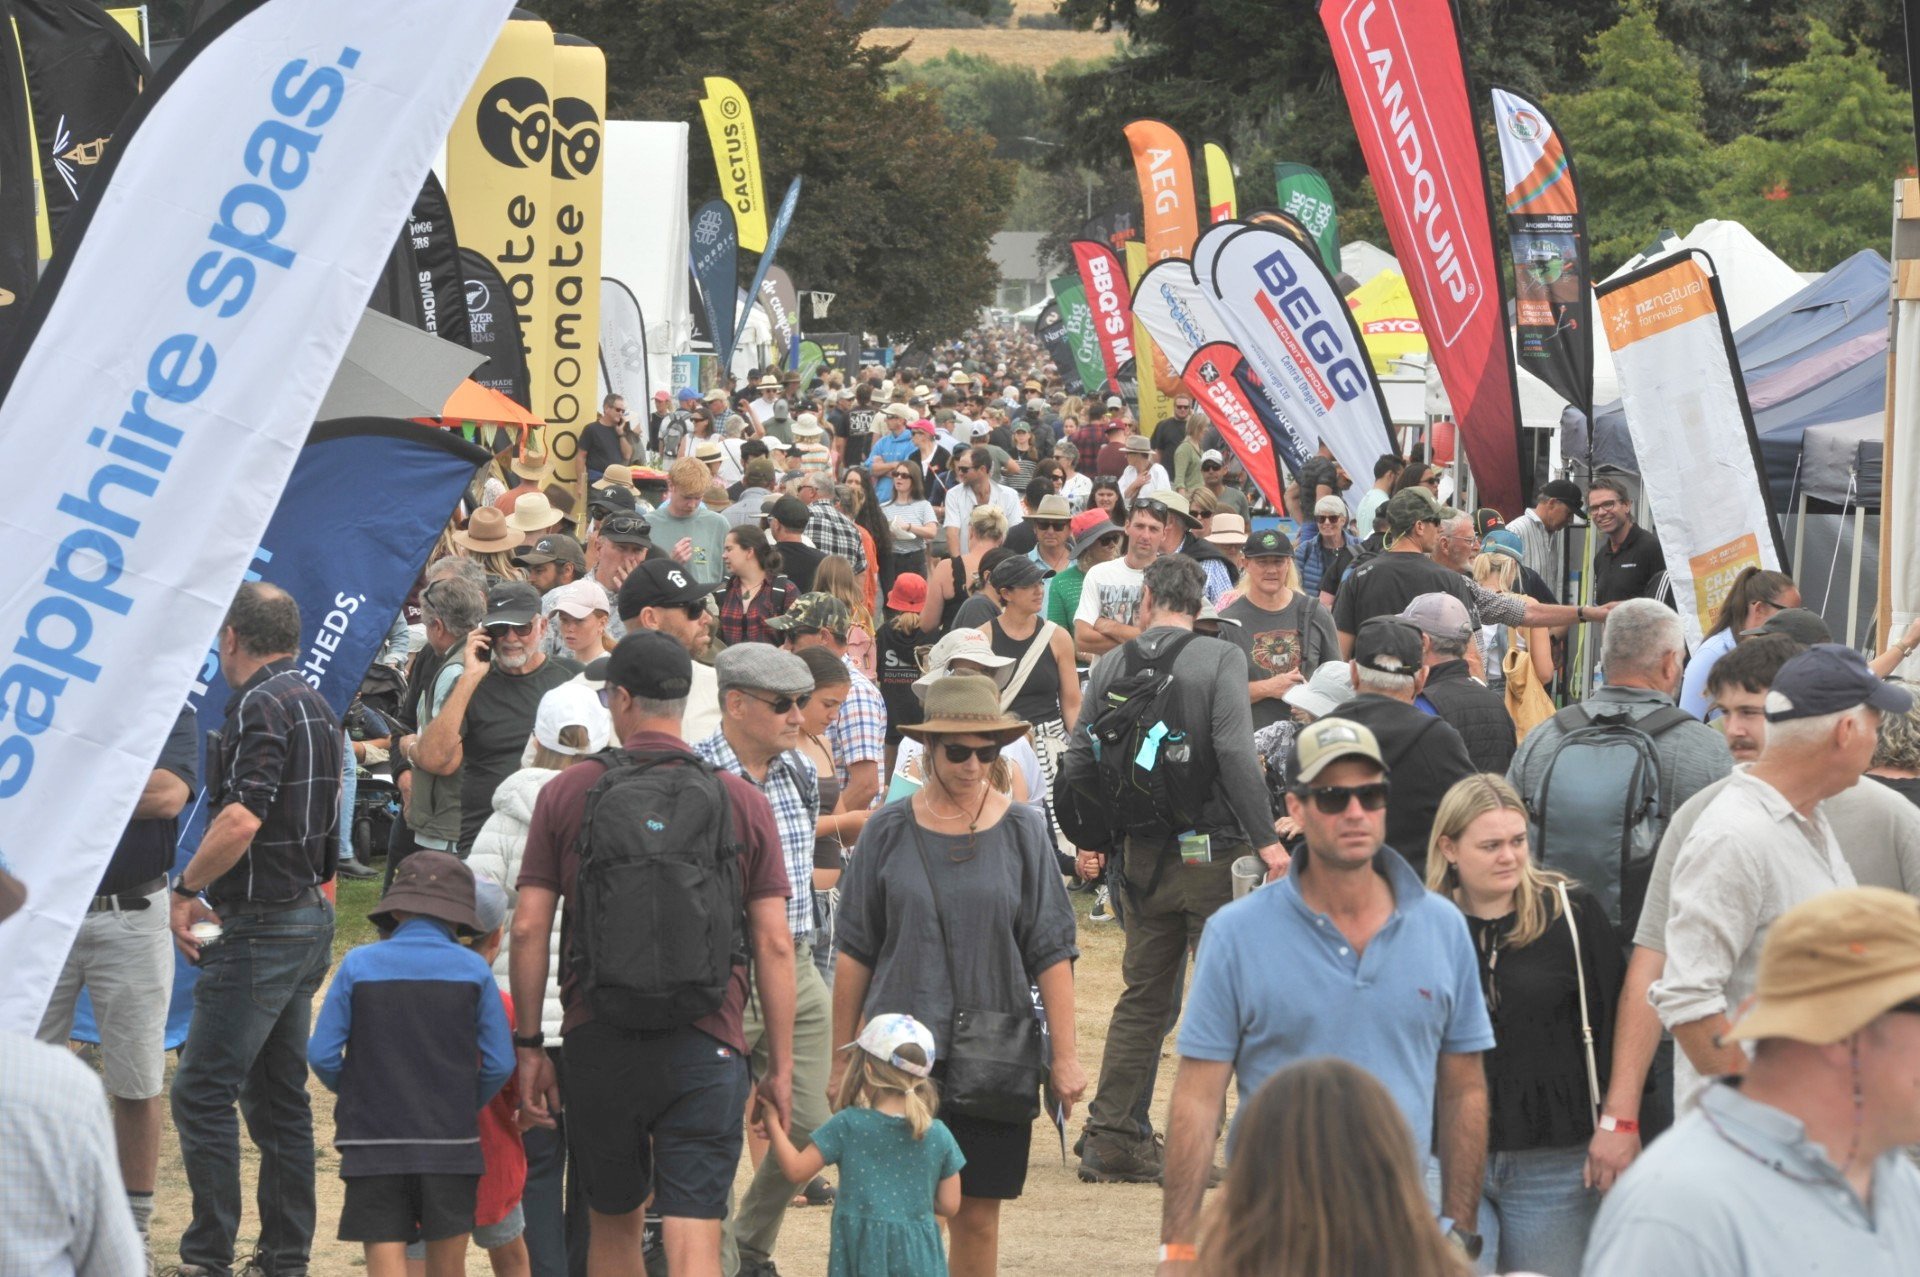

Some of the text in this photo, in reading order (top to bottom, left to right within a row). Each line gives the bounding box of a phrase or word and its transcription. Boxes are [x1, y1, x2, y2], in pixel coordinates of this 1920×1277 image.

[724, 124, 751, 213] CACTUS
[1147, 149, 1179, 215] AEG
[1358, 0, 1467, 303] LANDQUIP
[697, 232, 733, 270] NORDIC
[1308, 201, 1332, 238] Egg
[1067, 303, 1088, 334] Big
[1089, 256, 1124, 334] BBQ'S
[1253, 250, 1367, 403] BEGG
[1367, 319, 1423, 333] RYO
[1640, 304, 1684, 327] formulas
[544, 204, 584, 483] robomate
[1272, 318, 1330, 401] SECURITY GROUP
[1208, 386, 1261, 454] CARRARO
[1217, 382, 1268, 447] ANTONIO
[1281, 355, 1326, 418] Central Otago Ltd
[0, 47, 361, 798] sapphire spas.
